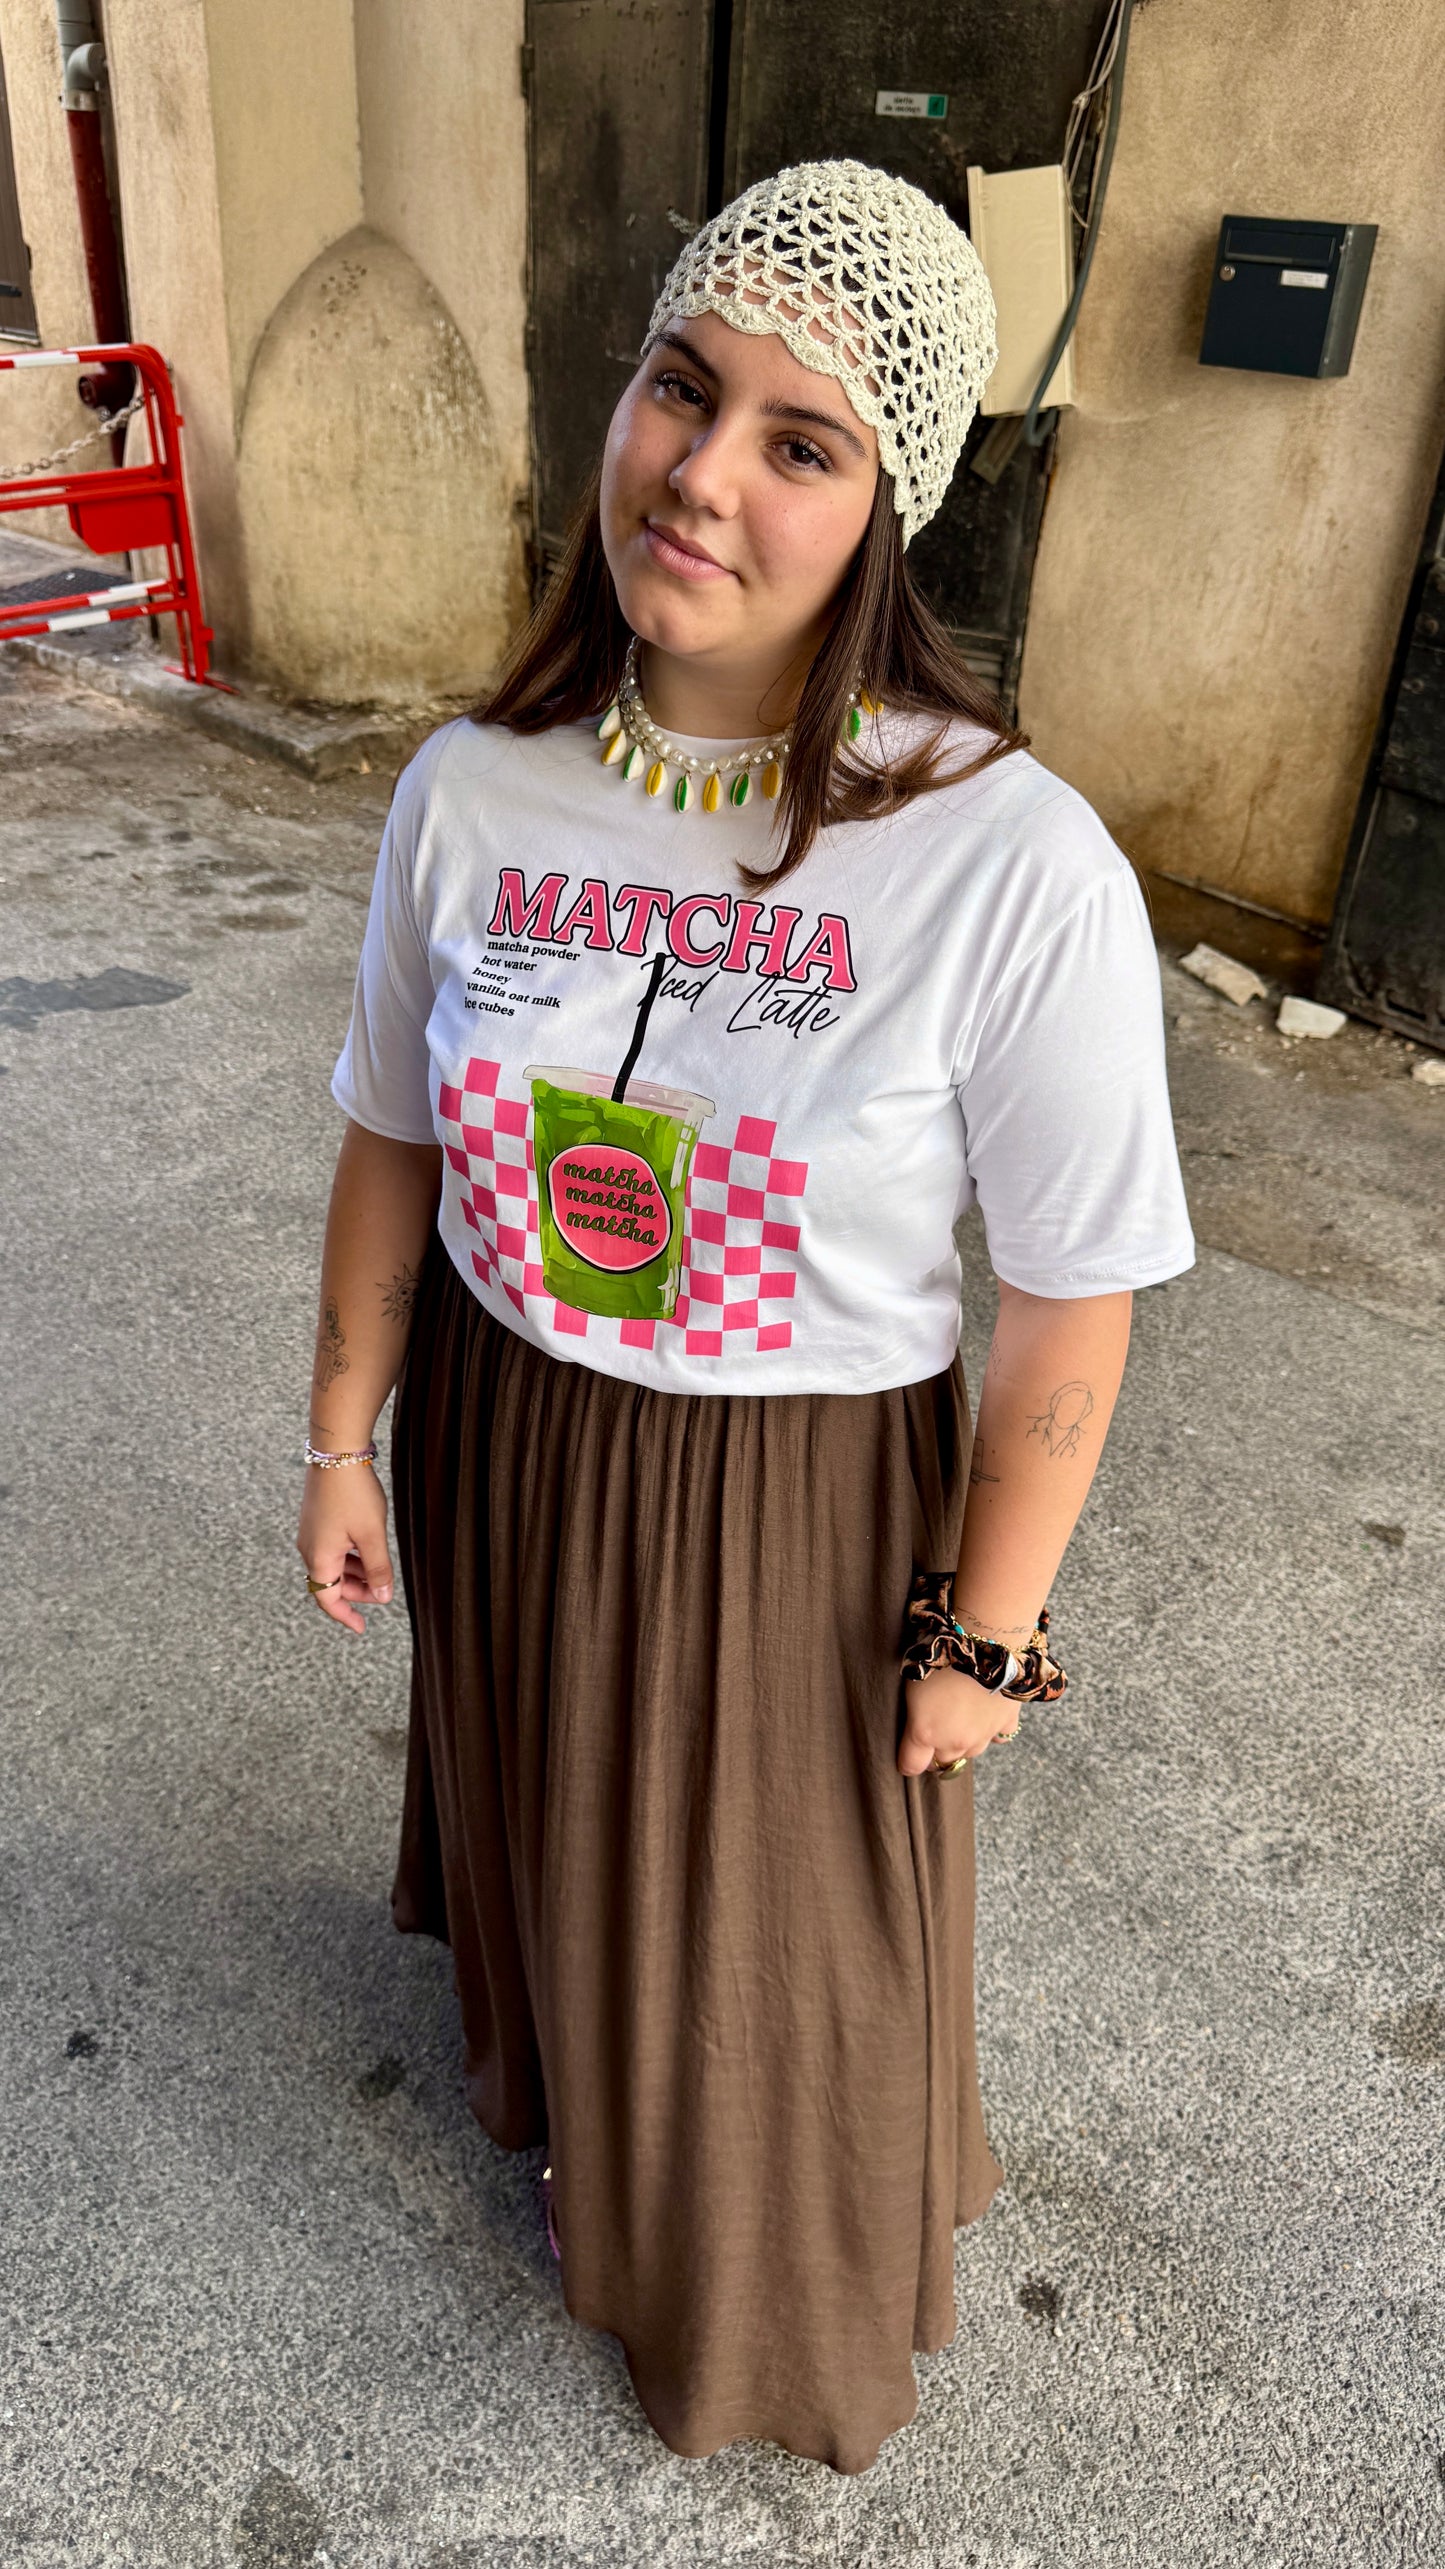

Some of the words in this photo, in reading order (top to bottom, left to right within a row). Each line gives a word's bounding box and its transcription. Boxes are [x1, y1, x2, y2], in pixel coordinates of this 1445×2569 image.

[487, 868, 857, 992] MATCHA
[480, 955, 502, 967] hot
[504, 960, 537, 971] water
[487, 941, 530, 953] matcha
[531, 946, 581, 961] powder
[472, 967, 512, 985] honey
[464, 997, 477, 1009] ice
[478, 1001, 515, 1016] cubes
[467, 982, 507, 998] vanilla
[508, 993, 530, 1003] oat
[531, 996, 562, 1008] milk
[637, 953, 719, 1012] Iced
[727, 971, 840, 1039] Latte
[563, 1162, 656, 1196] matcha
[566, 1186, 657, 1219] matcha
[566, 1211, 659, 1246] matcha
